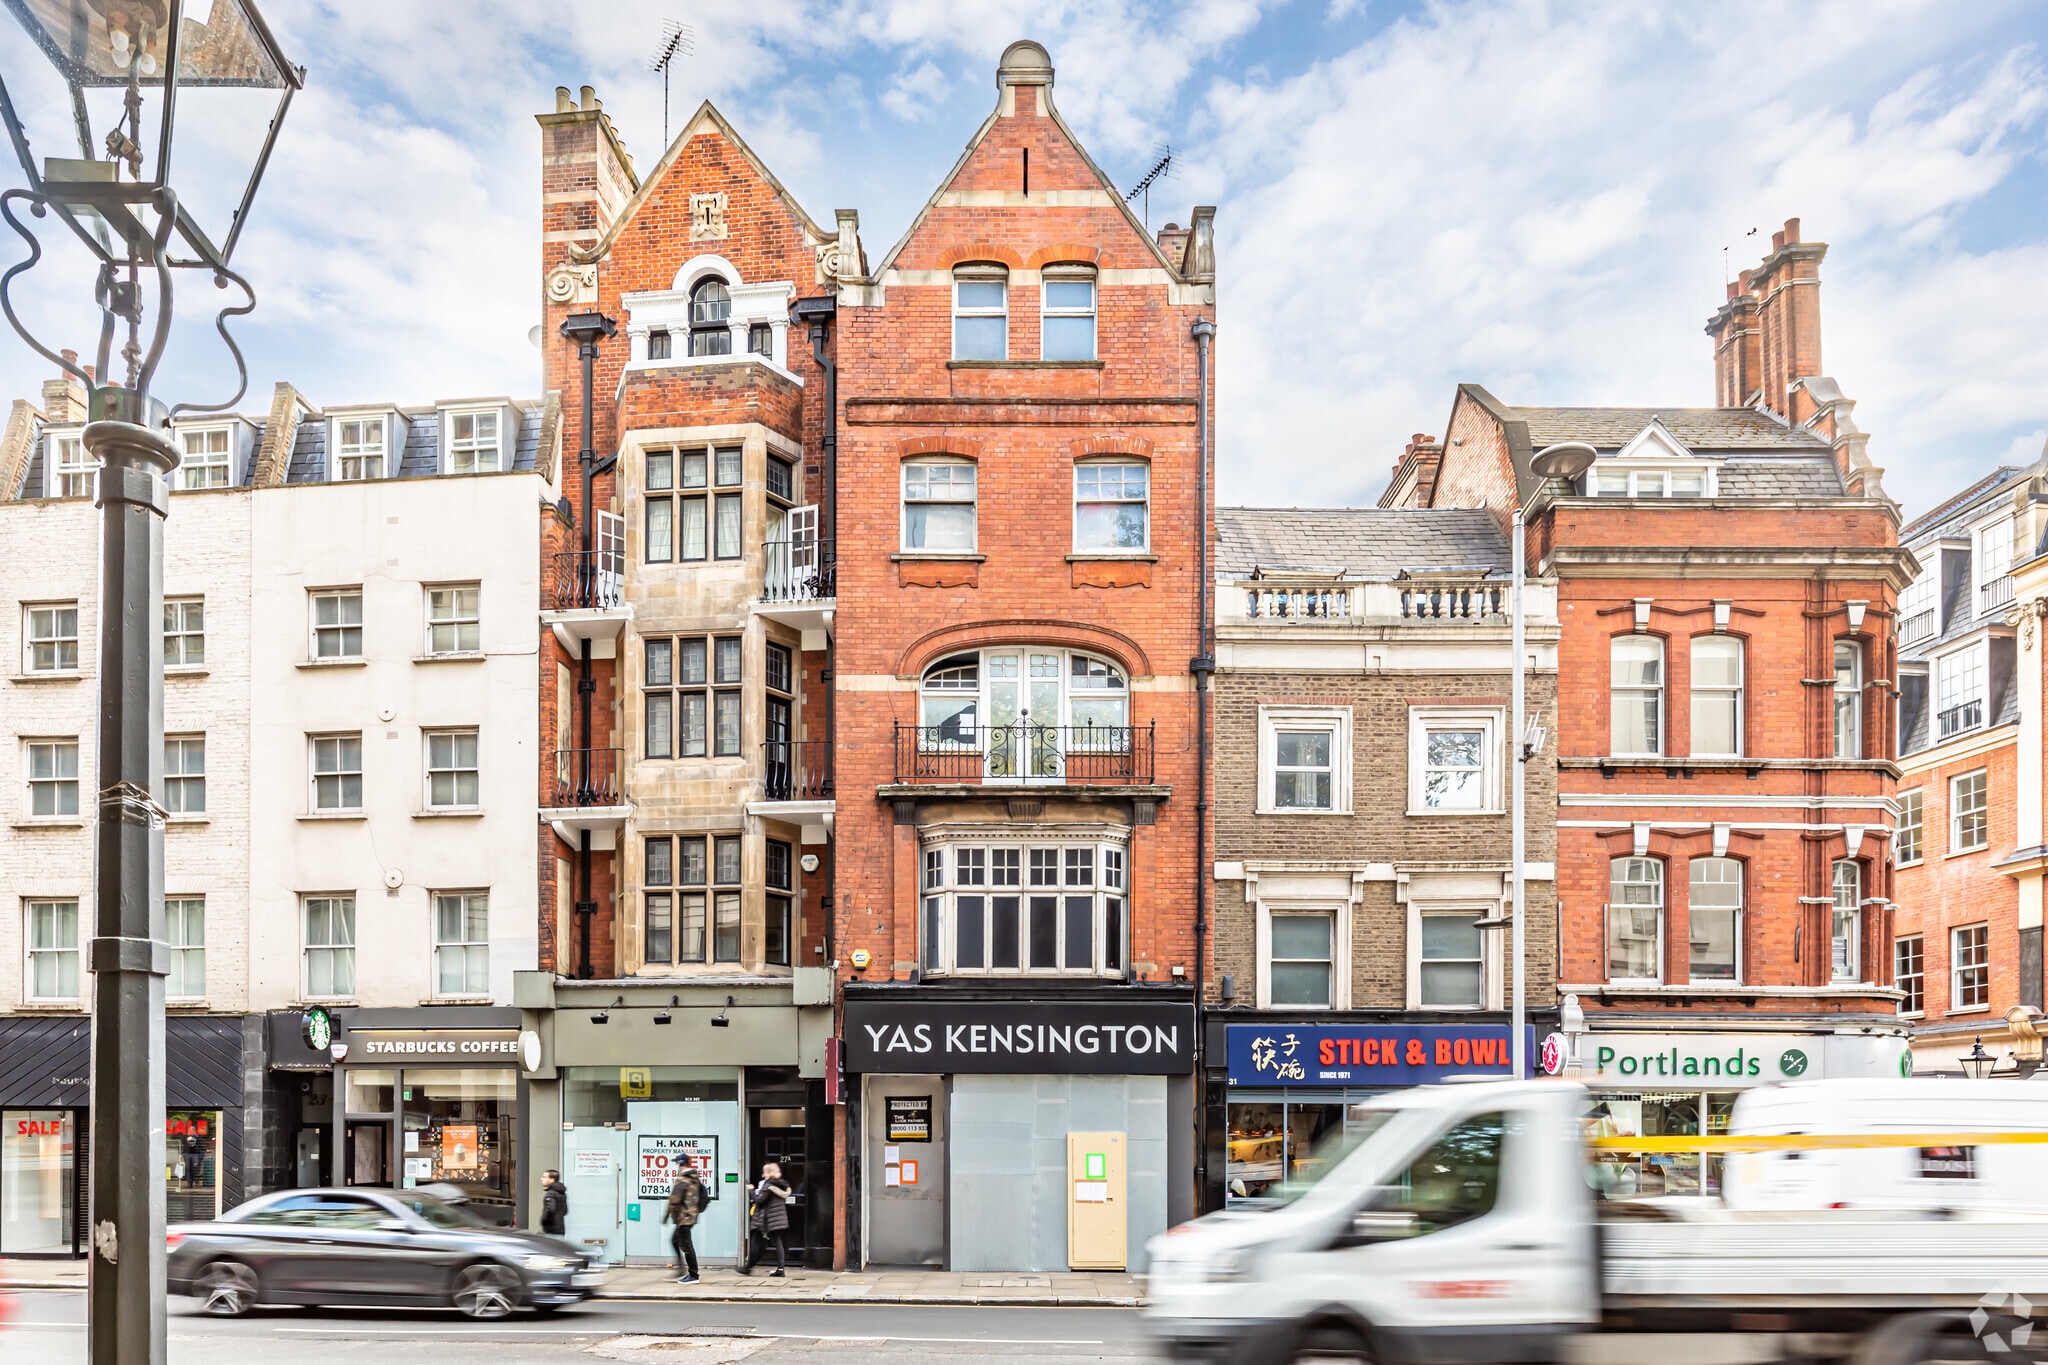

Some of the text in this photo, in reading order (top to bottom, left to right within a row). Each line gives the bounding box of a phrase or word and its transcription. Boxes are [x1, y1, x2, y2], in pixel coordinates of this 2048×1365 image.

[863, 1024, 1178, 1054] YAS KENSINGTON
[366, 1041, 518, 1053] STARBUCKS COFFEE
[1318, 1038, 1399, 1066] STICK
[1405, 1039, 1428, 1066] &
[1435, 1039, 1511, 1066] BOWL
[1597, 1046, 1761, 1076] Portlands
[1319, 1071, 1337, 1079] SINCE
[18, 1120, 60, 1135] SALE
[166, 1120, 208, 1135] SALE
[656, 1140, 698, 1148] H. KANE
[642, 1155, 669, 1169] TO
[641, 1185, 671, 1195] 07834
